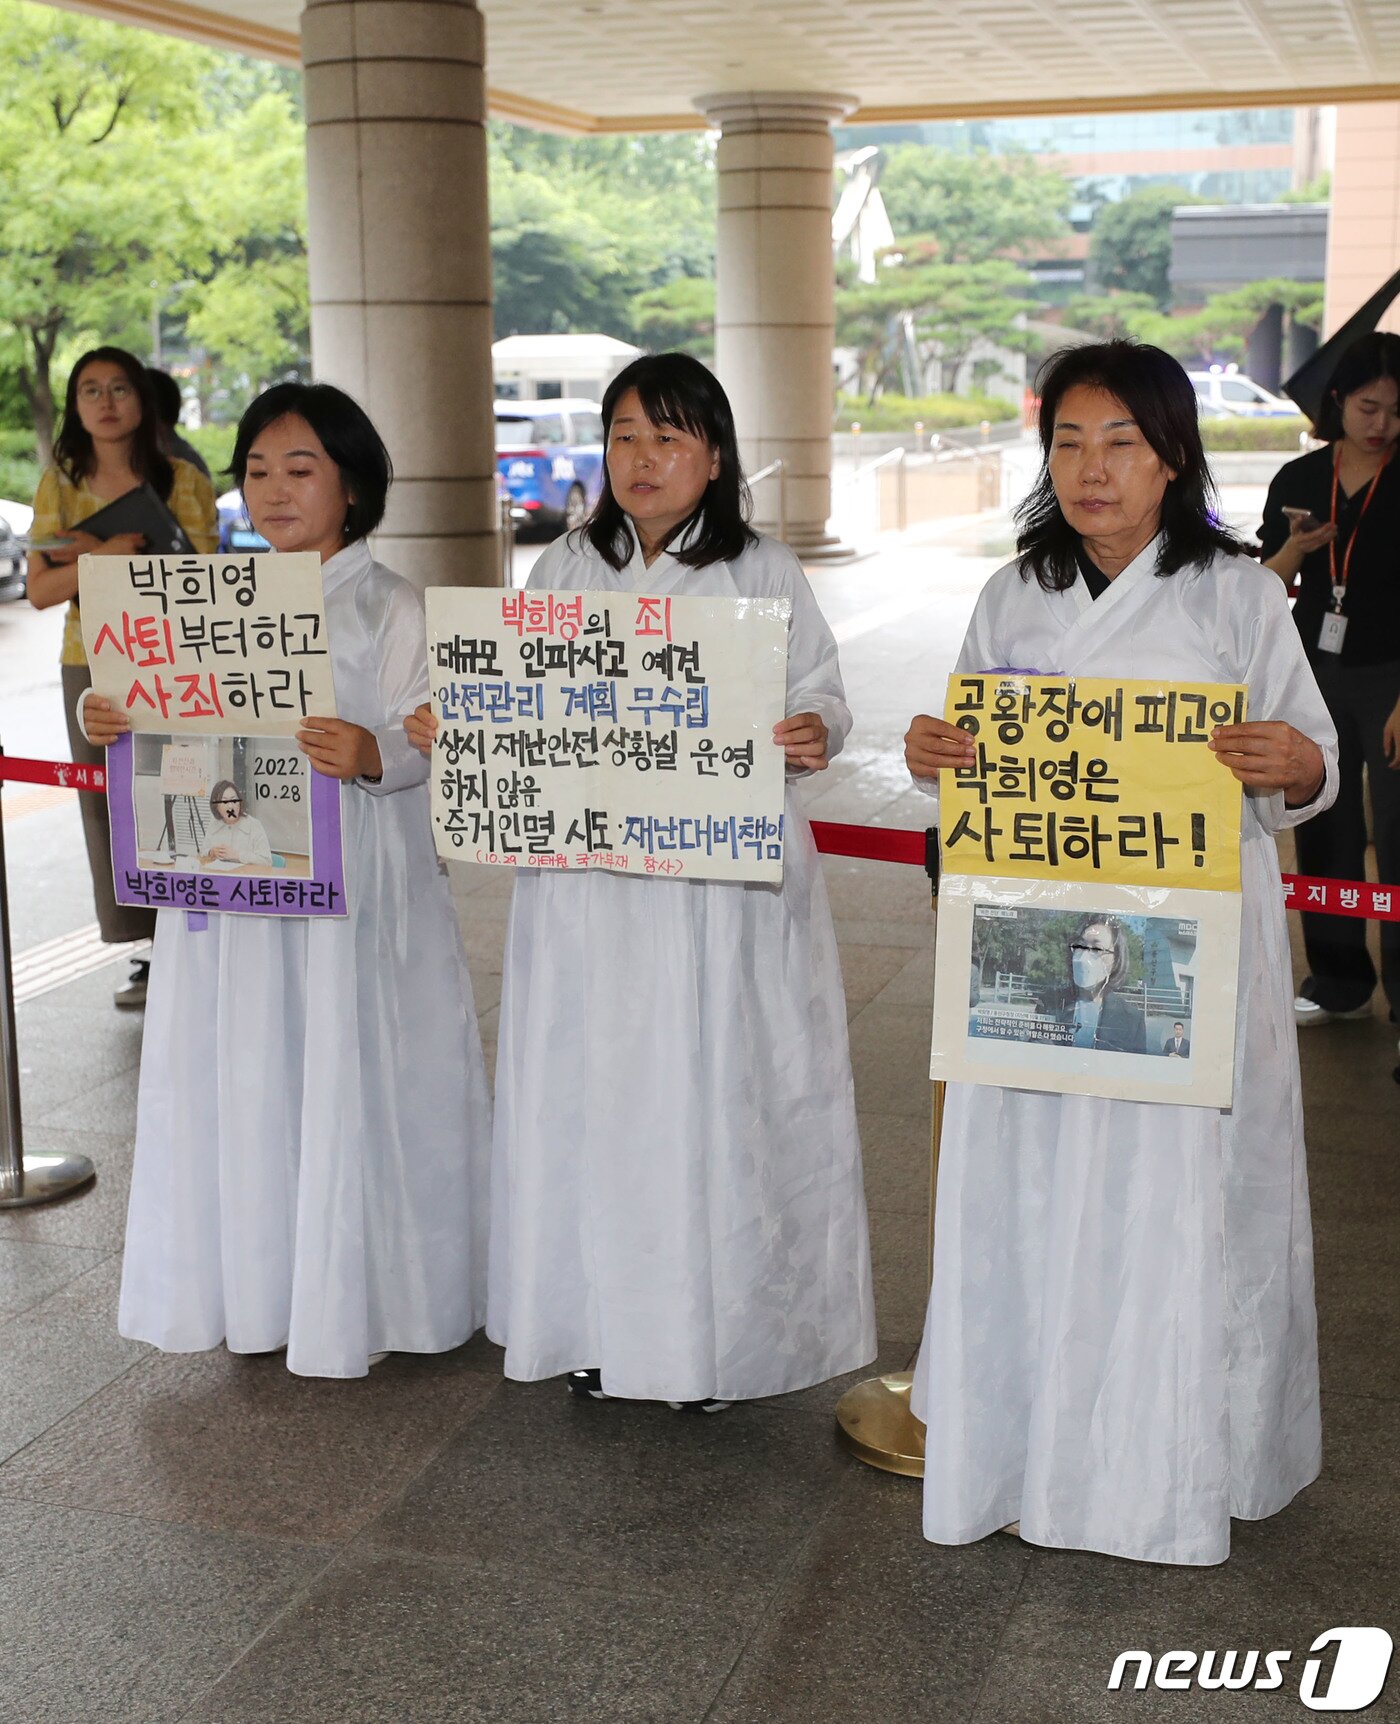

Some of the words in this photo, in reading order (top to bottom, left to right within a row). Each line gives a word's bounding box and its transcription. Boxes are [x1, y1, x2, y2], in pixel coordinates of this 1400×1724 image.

[129, 557, 256, 614] 박희영
[94, 611, 327, 667] 사퇴부터하고
[502, 591, 611, 640] 박희영의
[635, 597, 672, 642] 죄
[437, 634, 503, 676] 대규모
[519, 637, 628, 678] 인파사고
[642, 641, 706, 684] 예견
[126, 669, 312, 718] 사죄하라
[438, 681, 544, 723] 안전관리
[560, 681, 618, 723] 계획
[626, 686, 709, 728] 무수립
[955, 679, 1123, 745] 공황장애
[254, 757, 304, 776] 2022.
[438, 728, 486, 765] 상시
[690, 739, 754, 778] 운영
[955, 742, 1119, 804] 박희영은
[255, 783, 301, 803] 10.28
[440, 768, 488, 808] 하지
[497, 770, 541, 809] 않음
[444, 809, 555, 853] 증거인멸
[564, 808, 613, 852] 시도
[622, 814, 785, 860] 재난대비책임
[945, 807, 1206, 869] 사퇴하라!
[125, 871, 219, 906] 박희영은
[230, 880, 339, 909] 사퇴하라
